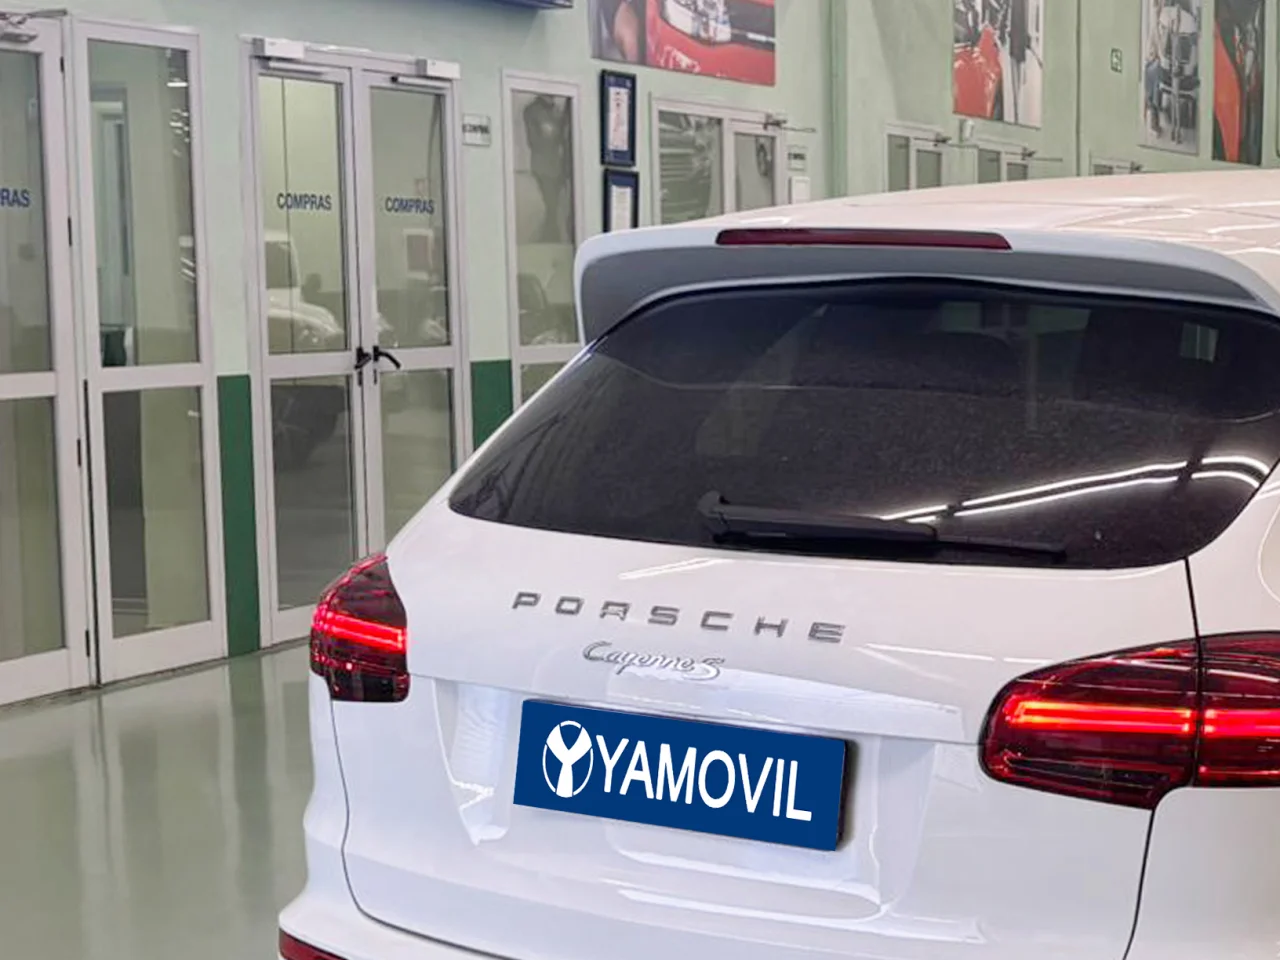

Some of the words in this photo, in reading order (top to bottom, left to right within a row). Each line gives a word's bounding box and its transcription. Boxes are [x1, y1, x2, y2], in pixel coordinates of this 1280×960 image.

[0, 187, 30, 208] RAS
[276, 193, 332, 211] COMPRAS
[385, 197, 434, 215] COMPRAS
[511, 591, 846, 644] PORSCHE
[582, 641, 696, 675] Cayenne
[683, 657, 726, 681] S
